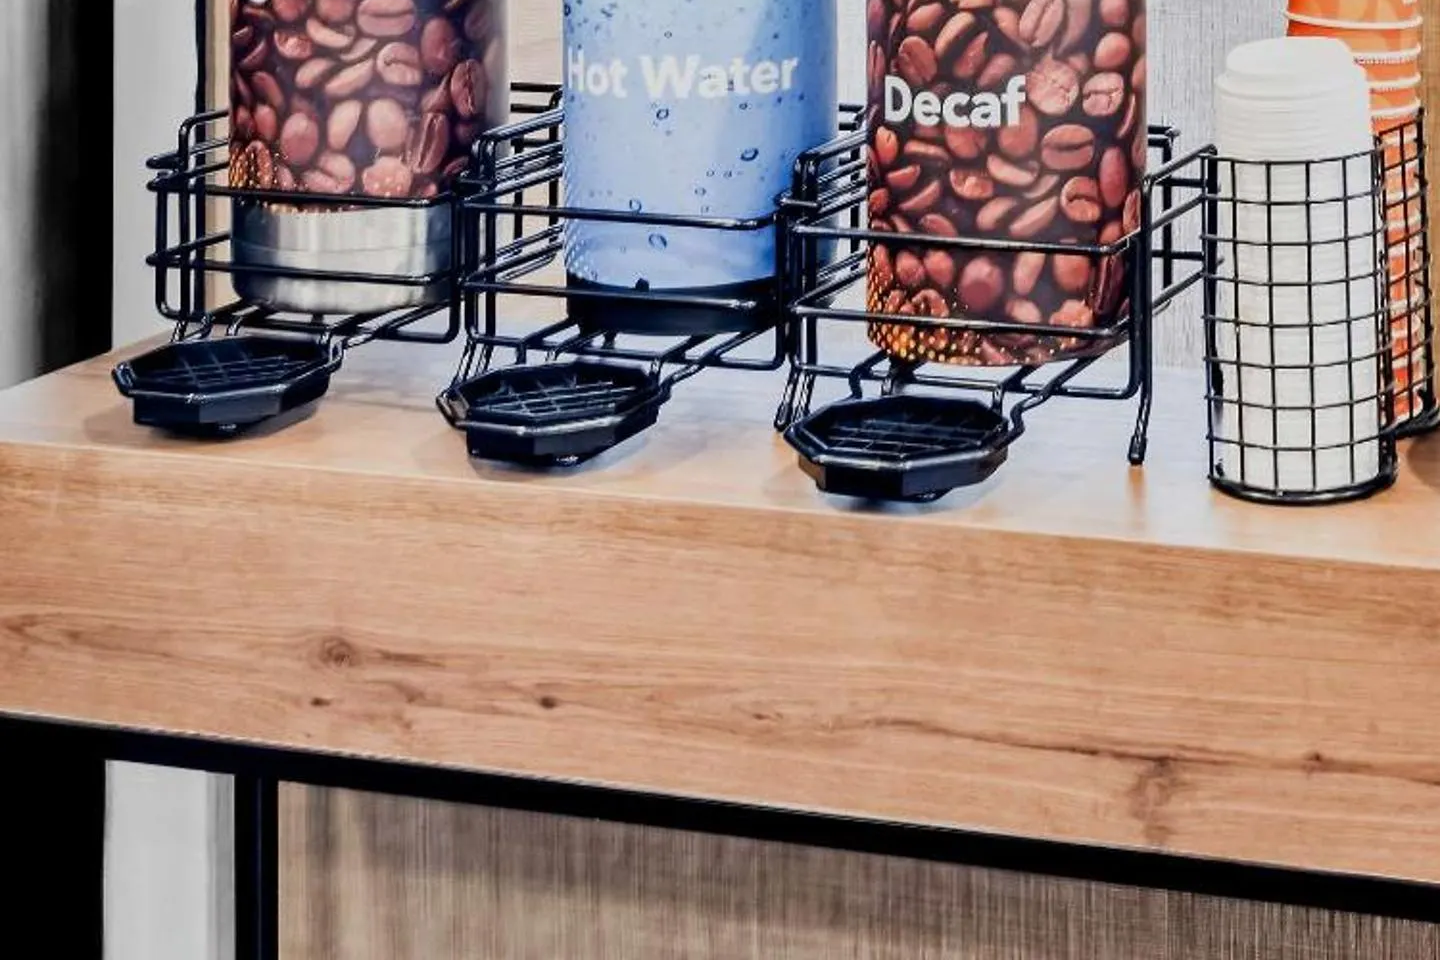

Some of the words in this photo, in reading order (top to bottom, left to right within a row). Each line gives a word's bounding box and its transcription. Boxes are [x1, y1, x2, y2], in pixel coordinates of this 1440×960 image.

[567, 45, 629, 98] Hot
[639, 53, 799, 98] Water
[884, 74, 1026, 128] Decaf
